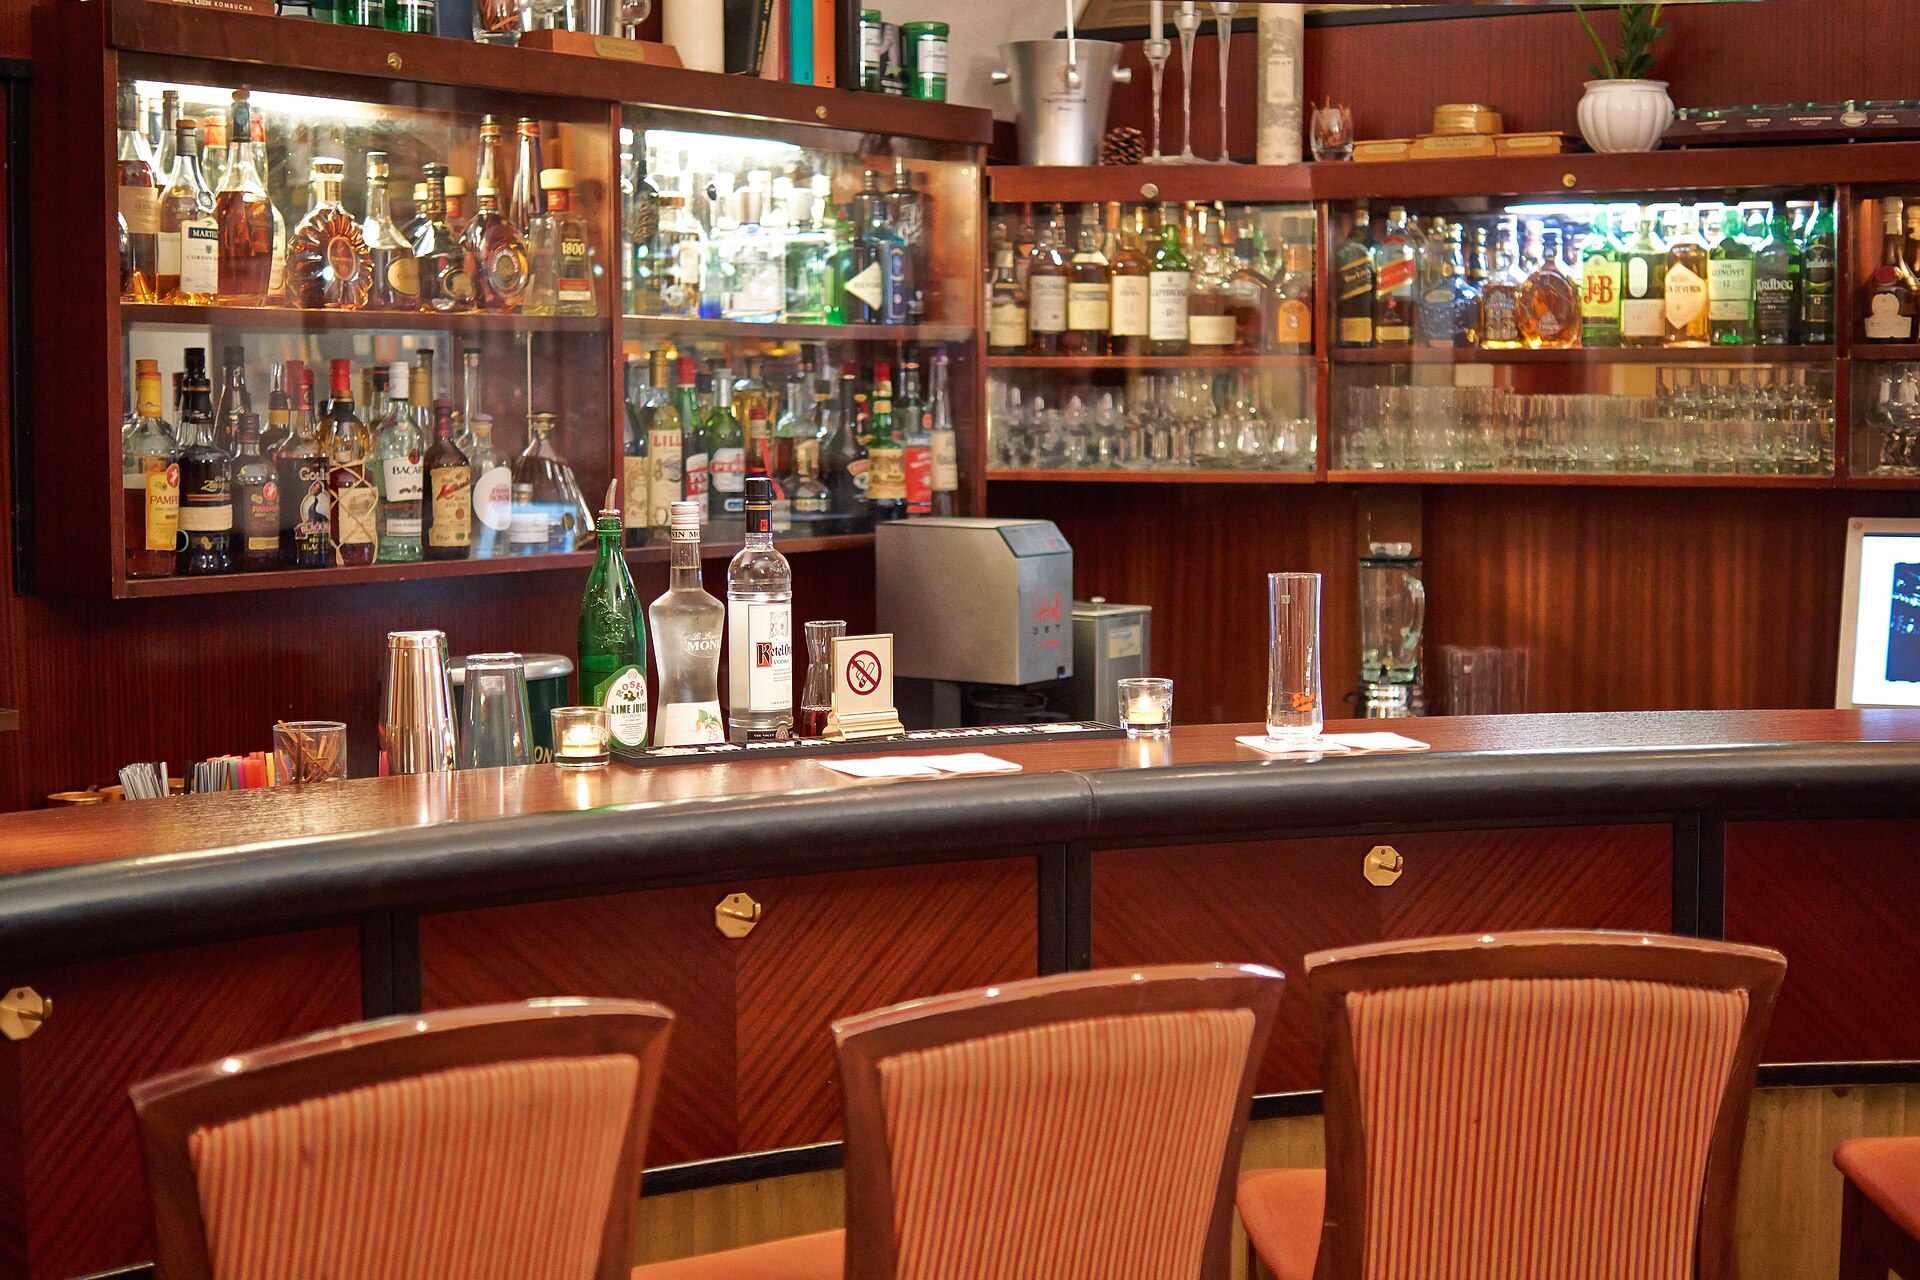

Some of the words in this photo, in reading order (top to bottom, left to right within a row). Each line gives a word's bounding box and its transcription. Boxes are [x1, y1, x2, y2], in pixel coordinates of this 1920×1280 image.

[214, 2, 253, 11] KOMBUCHA
[562, 242, 586, 255] 1800
[615, 681, 644, 697] ROSE'S
[611, 704, 631, 714] LIME
[632, 703, 647, 714] JUICE
[706, 731, 719, 741] 25
